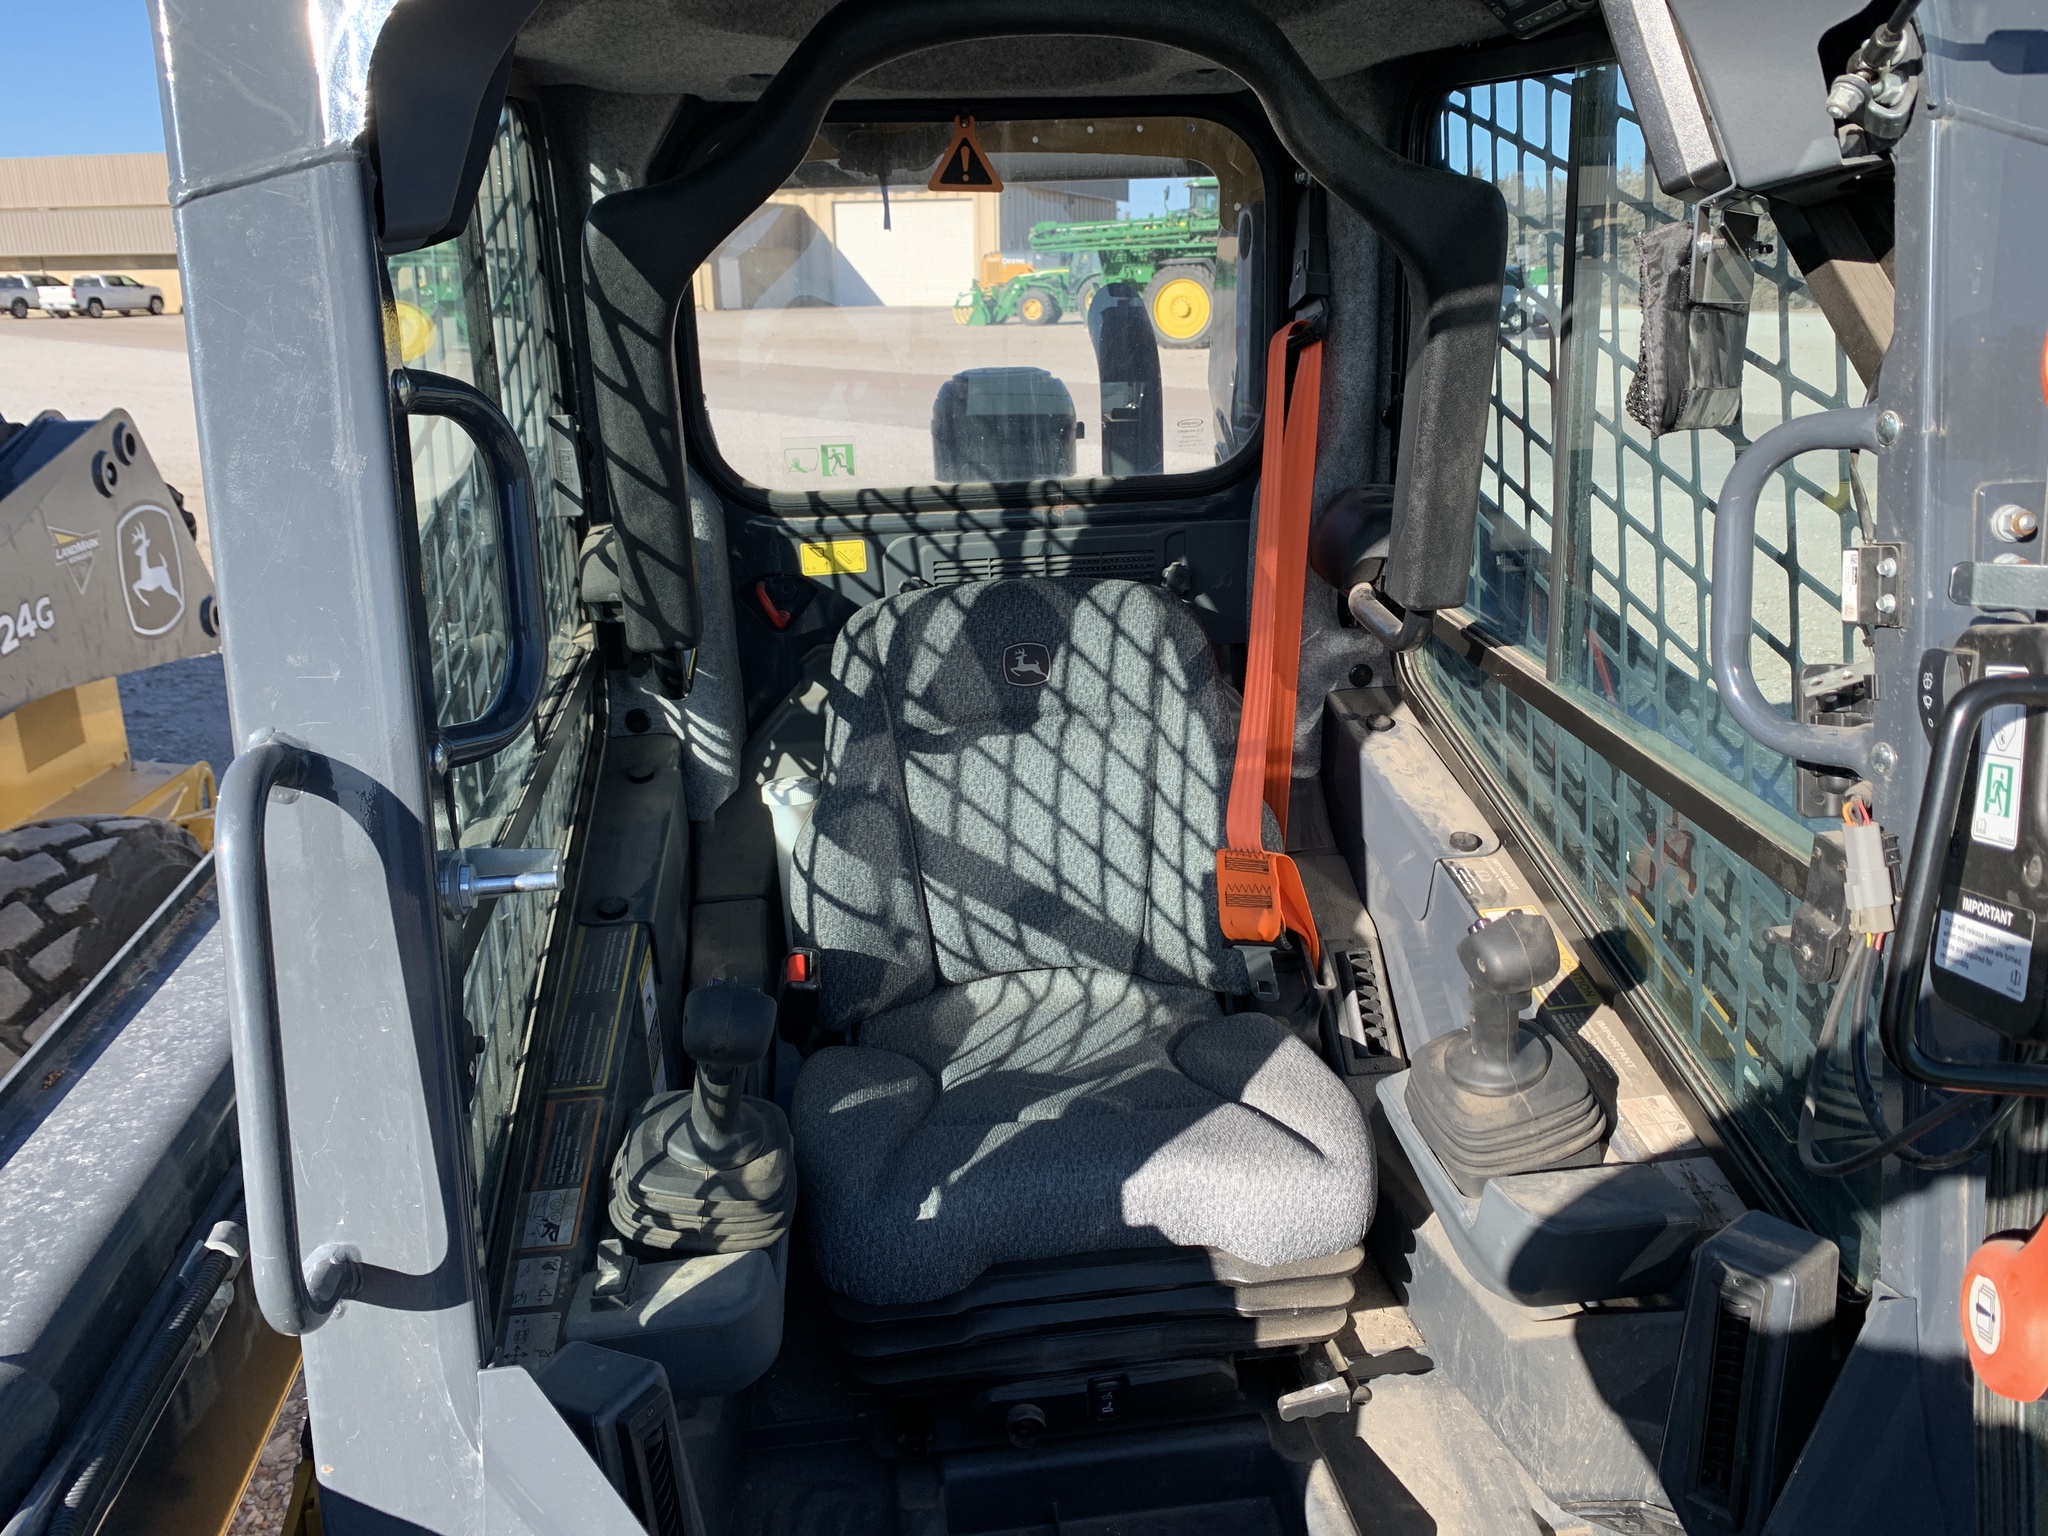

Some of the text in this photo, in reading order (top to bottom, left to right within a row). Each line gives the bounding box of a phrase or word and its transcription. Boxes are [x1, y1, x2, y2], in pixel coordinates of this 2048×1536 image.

[1963, 896, 2014, 926] IMPORTANT
[1945, 918, 1957, 927] Door
[1958, 923, 1966, 932] will
[1967, 925, 1984, 939] release
[1985, 932, 1997, 943] from
[1942, 940, 1955, 951] Tools
[1965, 950, 1985, 963] required
[1944, 931, 1957, 941] when
[1957, 936, 1974, 947] orange
[1975, 941, 1994, 955] handles
[1995, 950, 2003, 959] are
[1596, 1020, 1636, 1069] IMPORTANT
